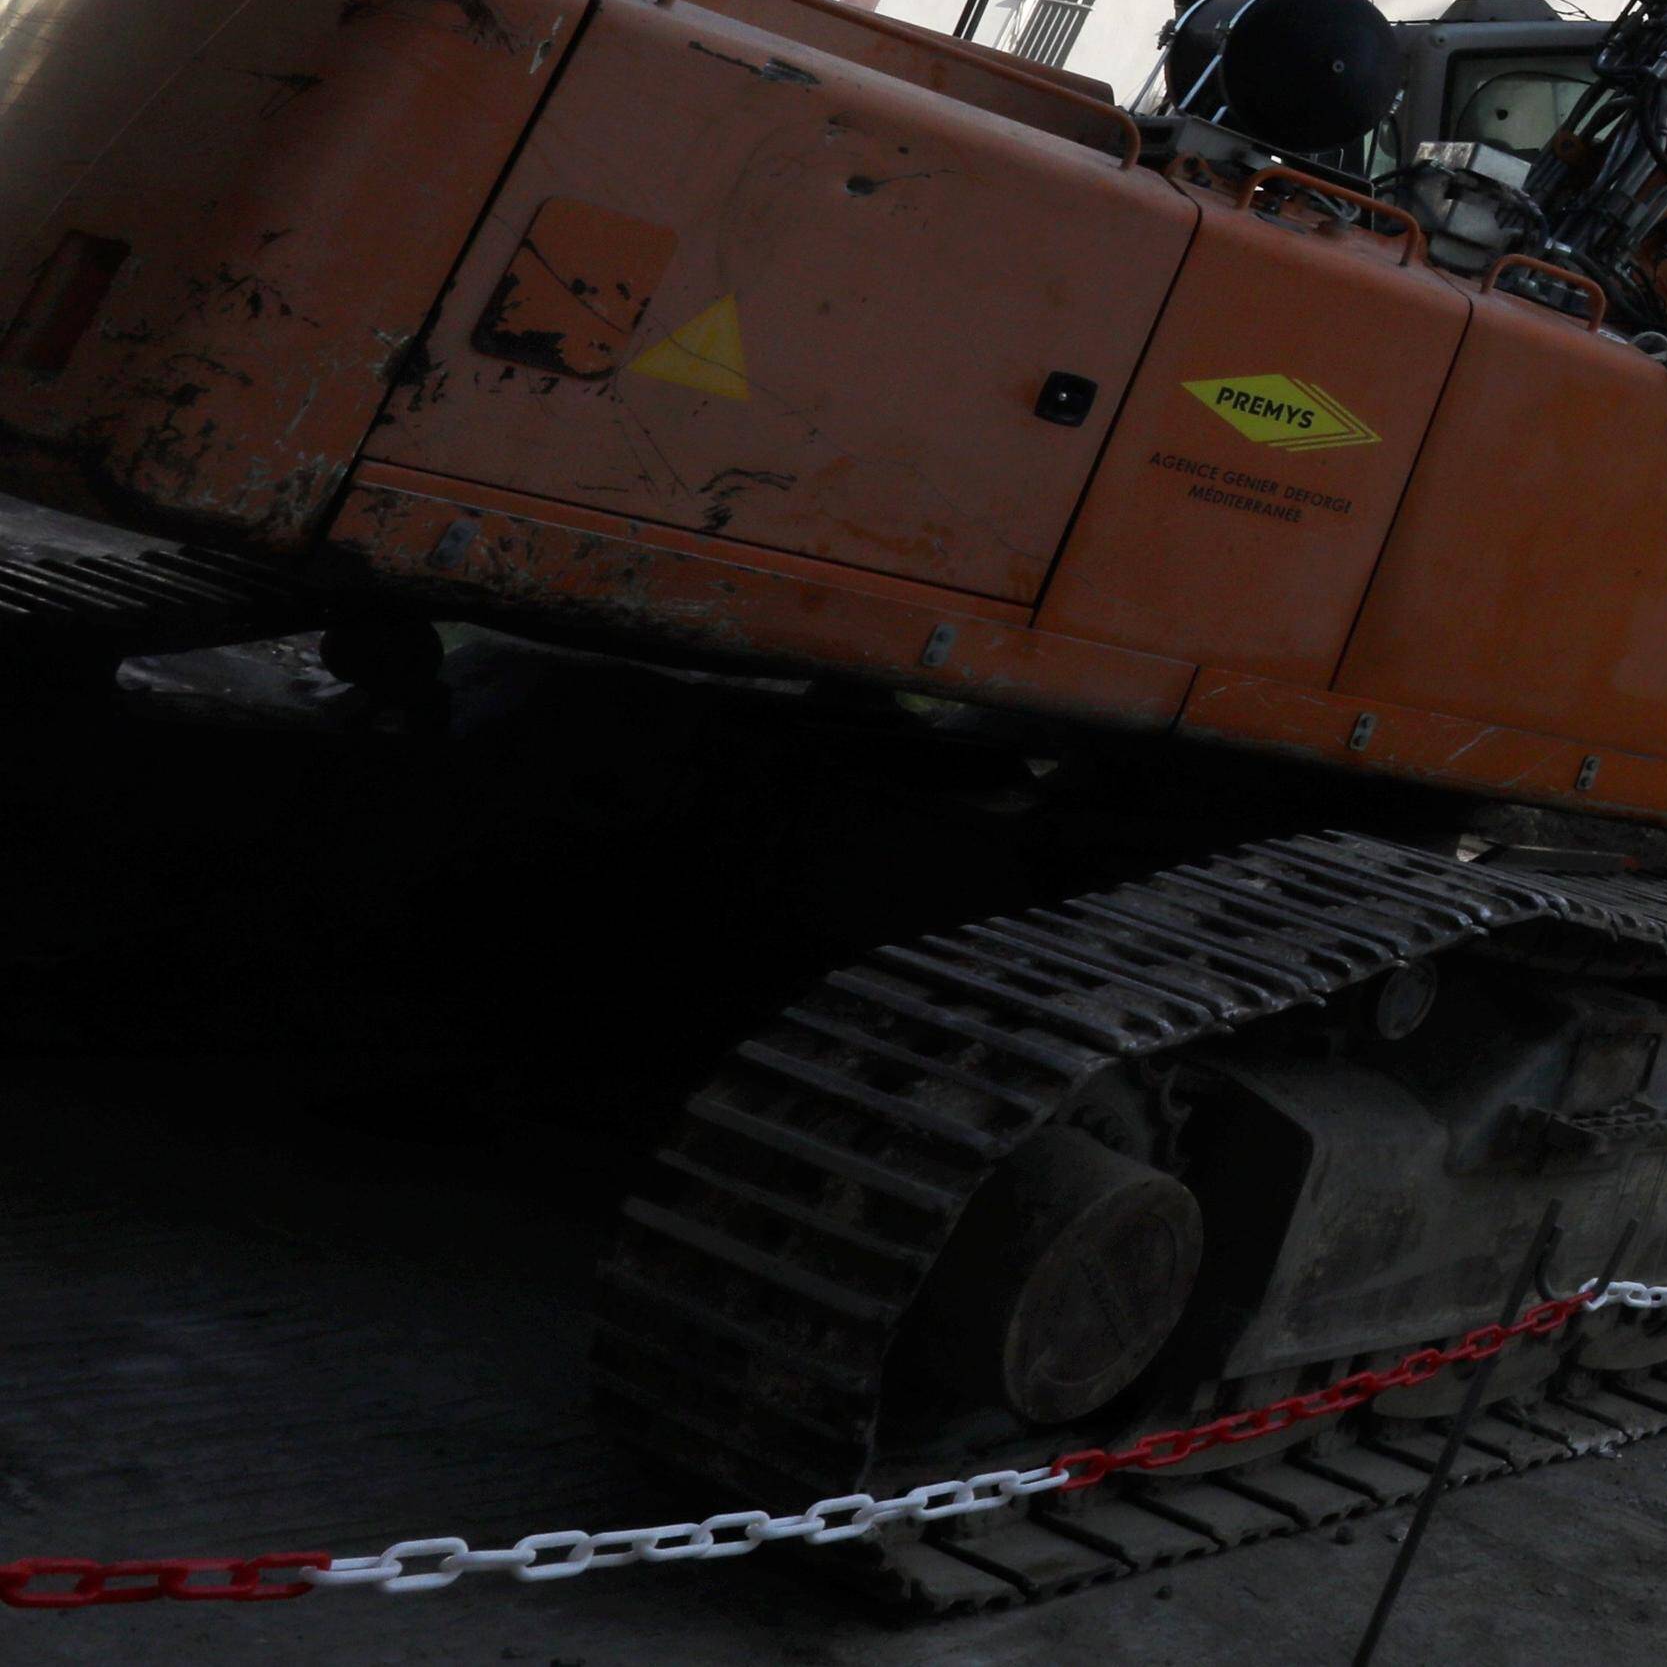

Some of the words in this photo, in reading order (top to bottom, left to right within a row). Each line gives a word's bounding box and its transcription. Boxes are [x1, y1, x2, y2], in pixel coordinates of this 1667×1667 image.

[1215, 386, 1316, 430] PREMYS
[1149, 451, 1220, 481] AGENCE
[1222, 470, 1279, 496] GENIER
